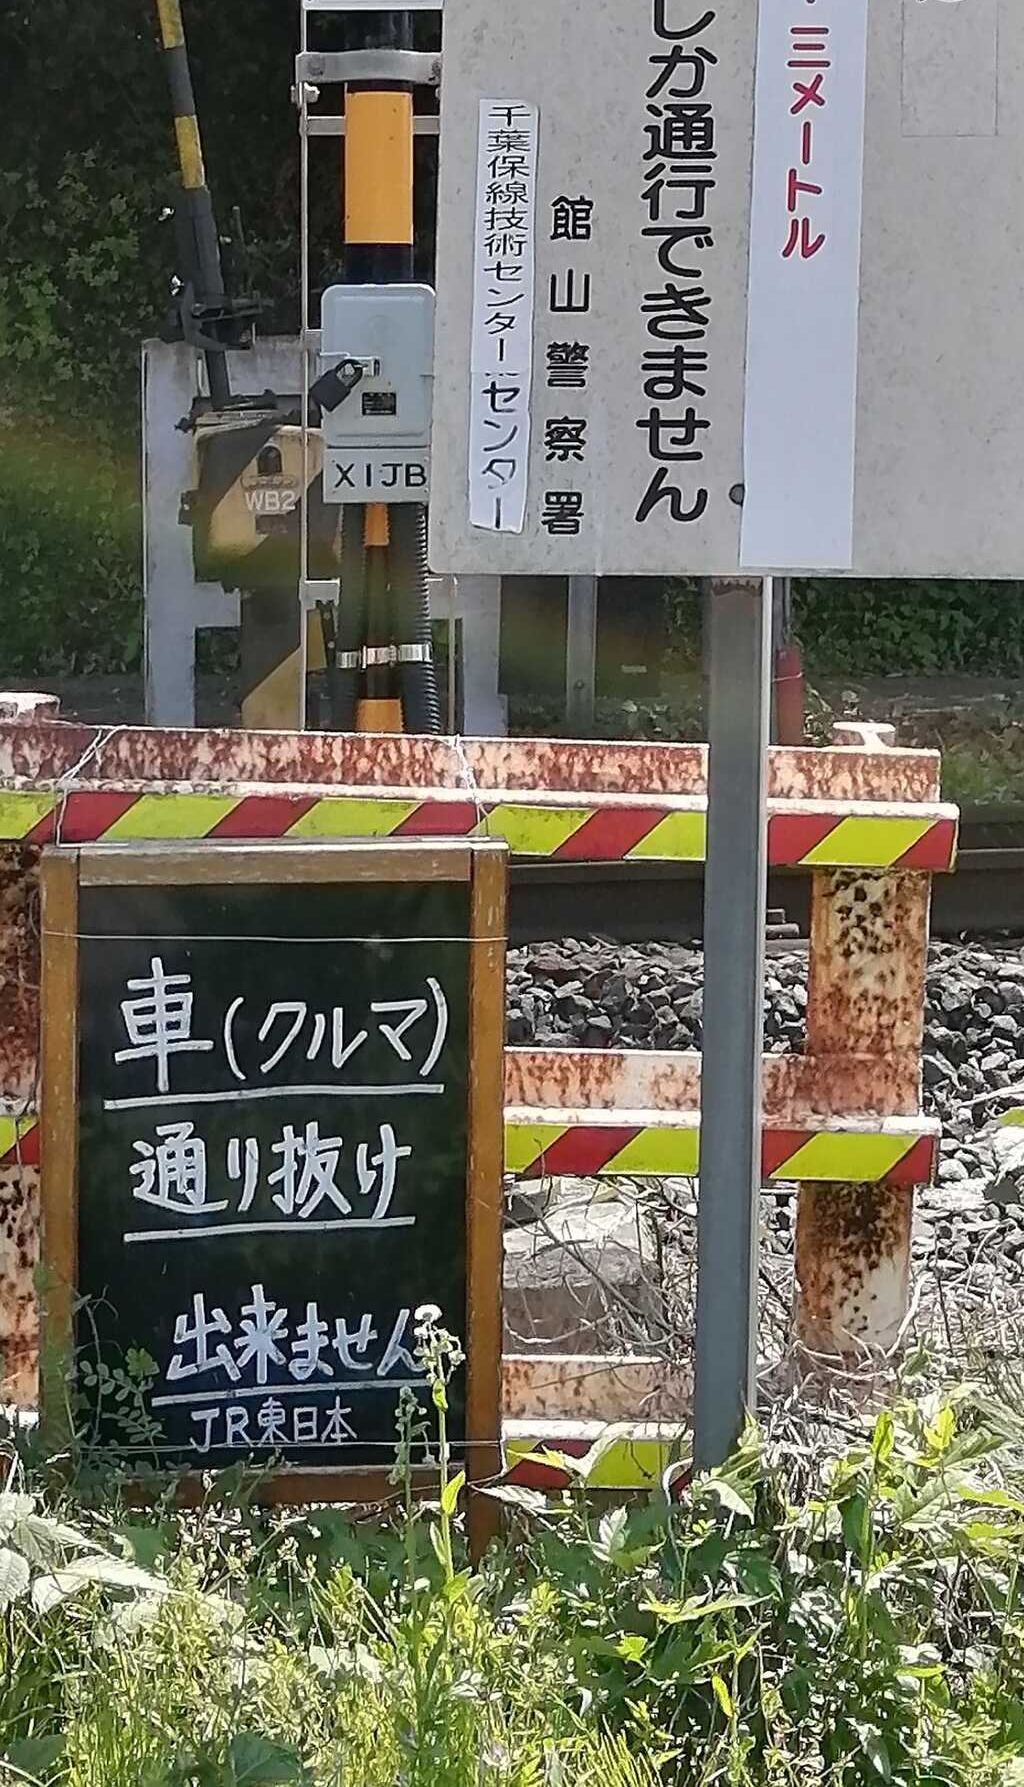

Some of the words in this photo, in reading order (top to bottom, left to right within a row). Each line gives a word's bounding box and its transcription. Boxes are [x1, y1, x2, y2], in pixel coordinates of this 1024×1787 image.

[541, 195, 594, 535] 館山警察署
[245, 490, 296, 511] WB2
[128, 1121, 412, 1219] 通り抜け
[166, 1283, 428, 1385] 出来ません
[190, 1396, 358, 1453] JR東日本
